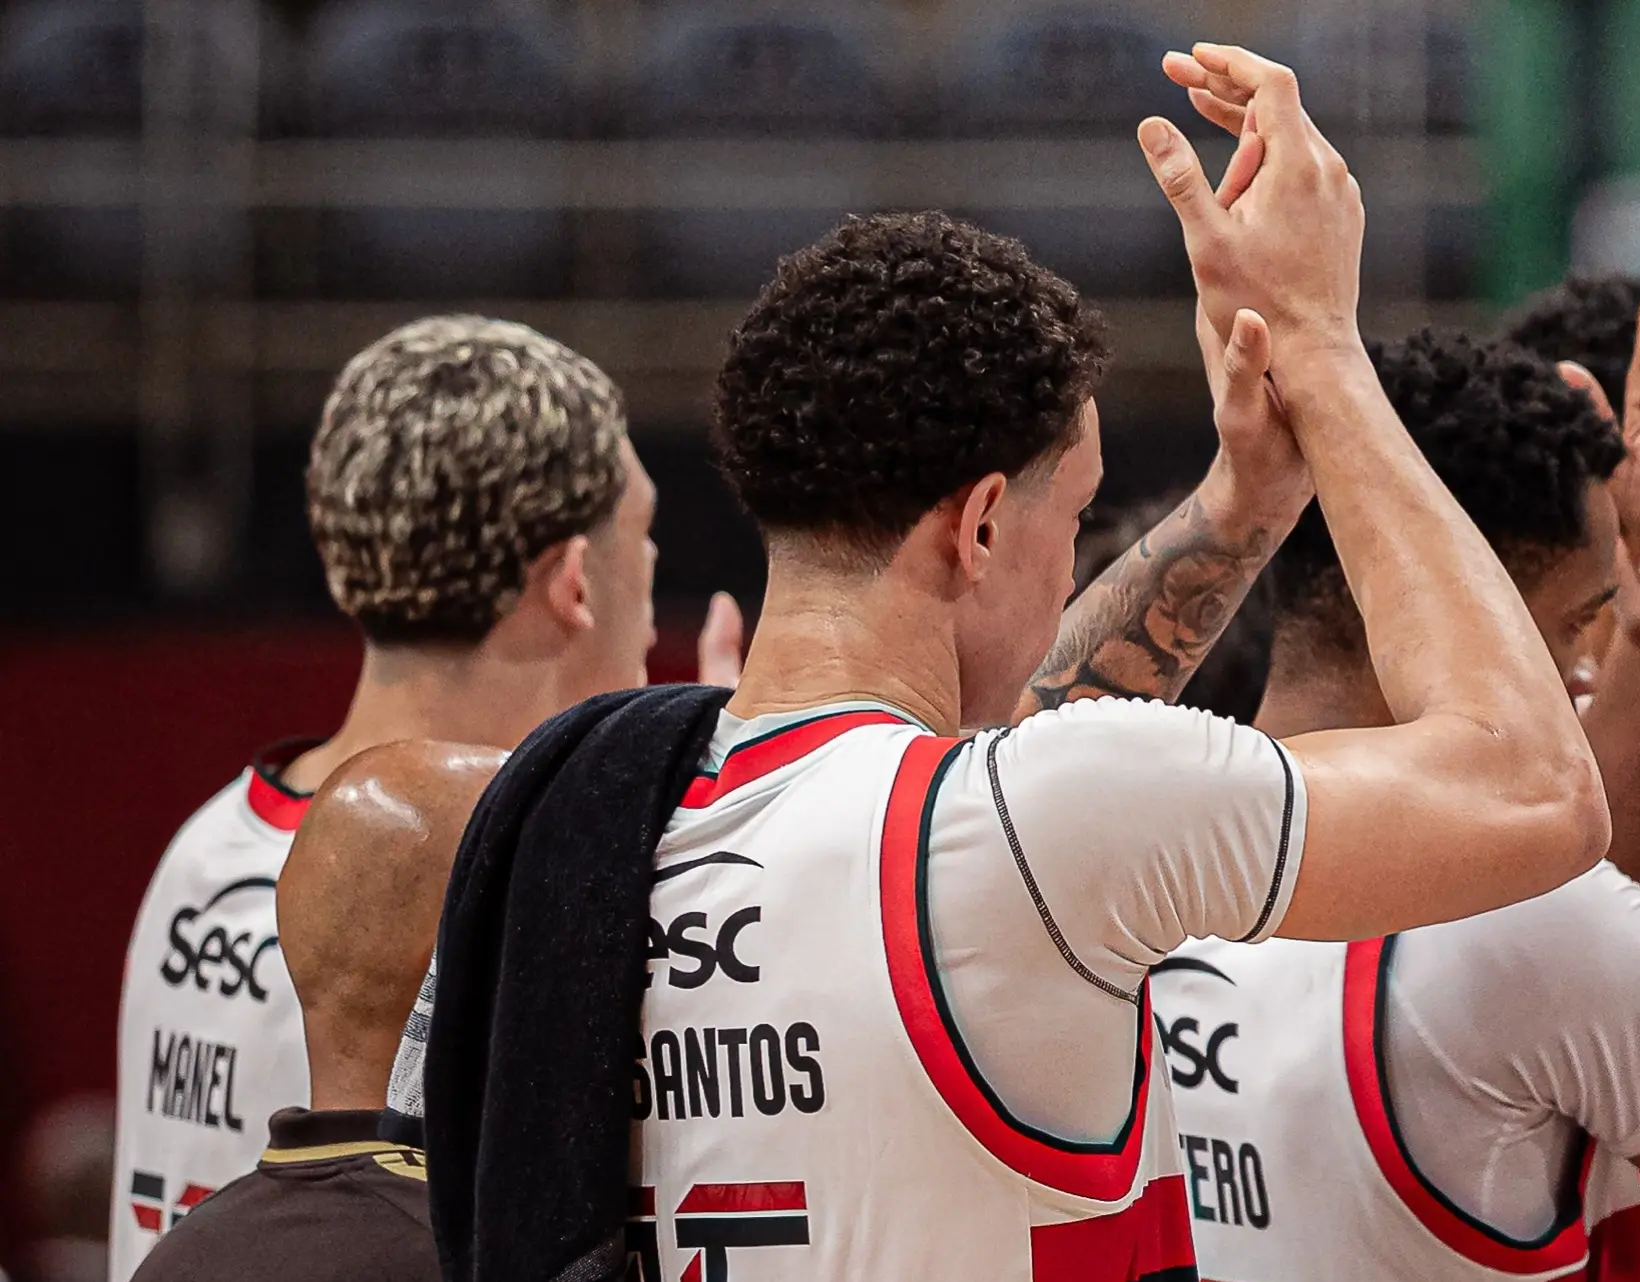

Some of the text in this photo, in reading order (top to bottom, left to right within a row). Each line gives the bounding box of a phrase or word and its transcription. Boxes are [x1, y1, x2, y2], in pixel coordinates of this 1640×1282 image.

[148, 1028, 244, 1133] MANEL
[1152, 1016, 1239, 1094] sc
[1178, 1132, 1270, 1230] ERO
